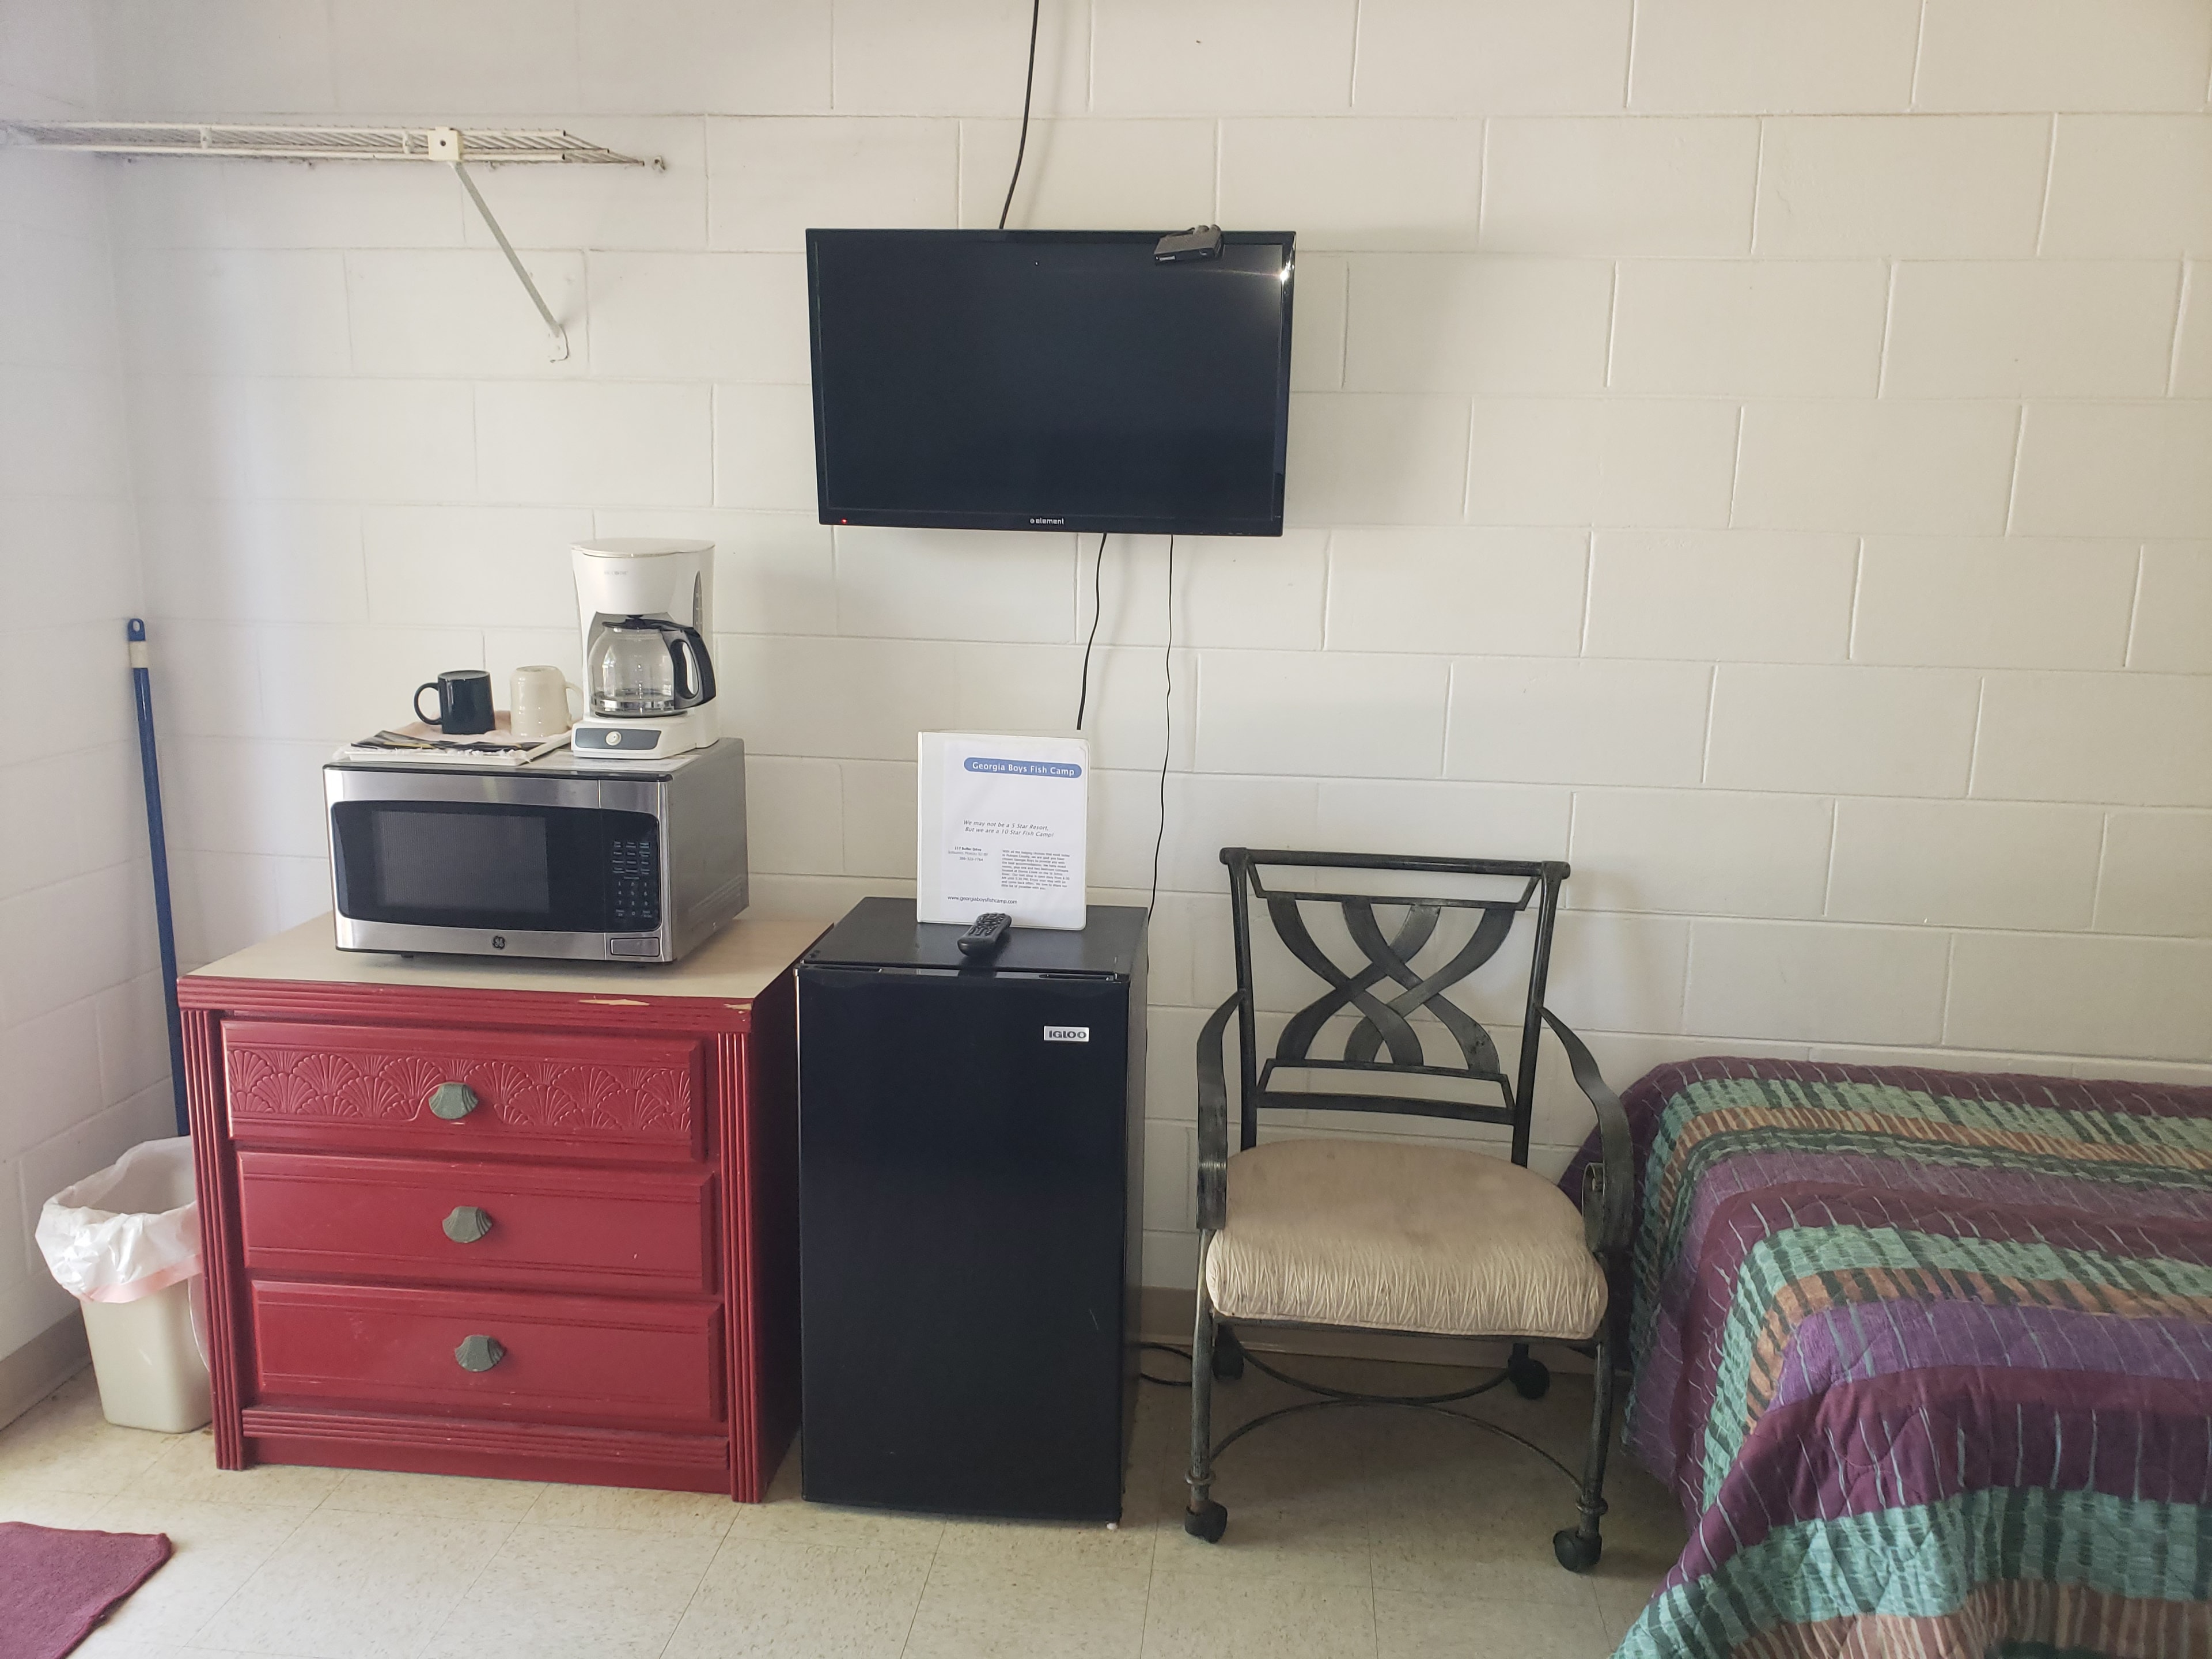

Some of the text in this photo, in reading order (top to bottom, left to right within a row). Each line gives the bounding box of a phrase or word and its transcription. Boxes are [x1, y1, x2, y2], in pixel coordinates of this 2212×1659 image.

[972, 762, 1075, 777] Georgia Boys Fish Camp
[1048, 1030, 1087, 1039] IGLOO
